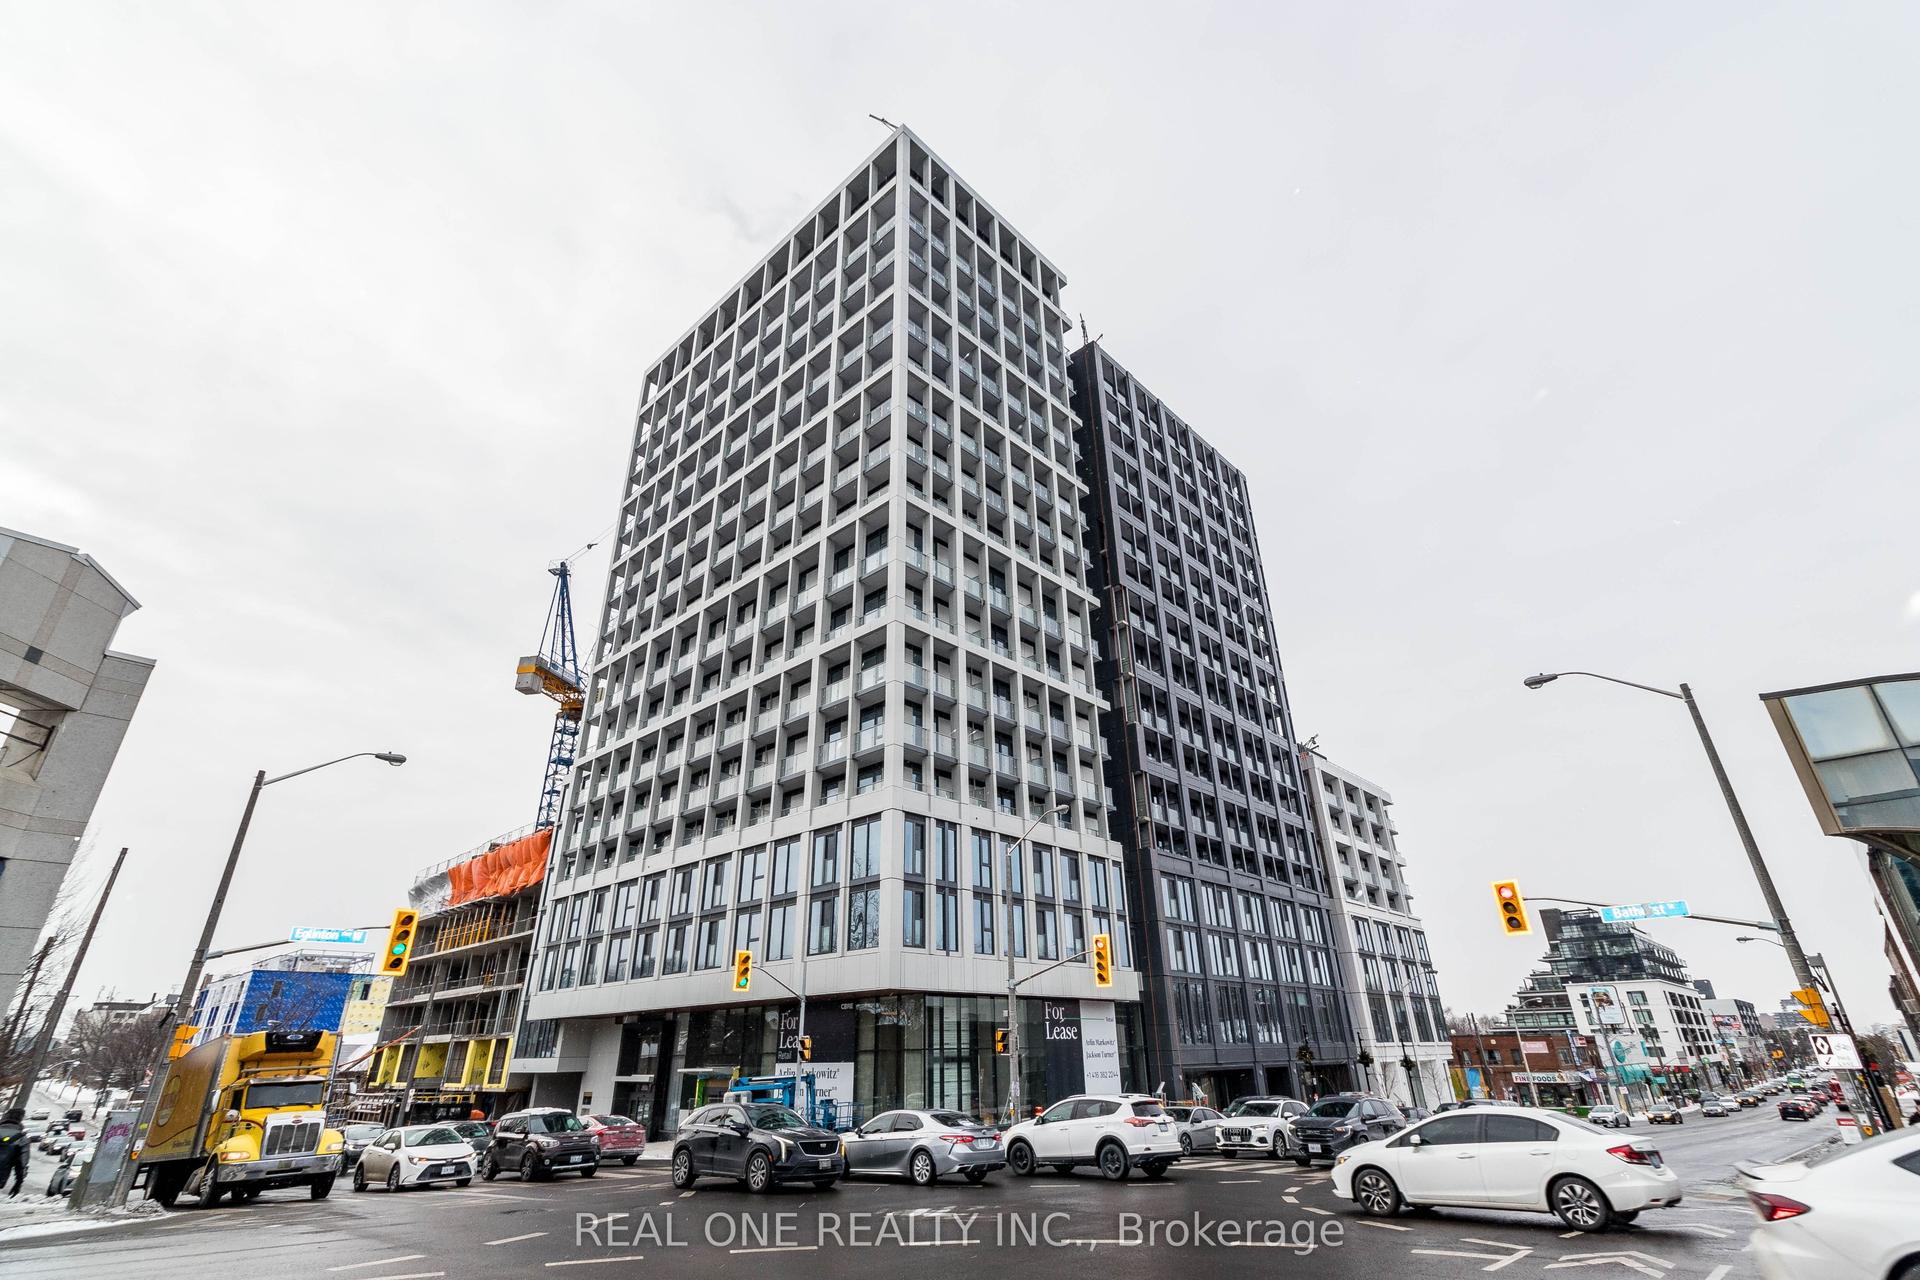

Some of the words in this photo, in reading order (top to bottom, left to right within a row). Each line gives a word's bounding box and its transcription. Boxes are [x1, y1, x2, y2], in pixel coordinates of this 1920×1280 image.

[780, 1010, 799, 1030] For
[1044, 1002, 1065, 1022] For
[1045, 1021, 1078, 1040] Lease
[779, 1032, 800, 1049] Lea
